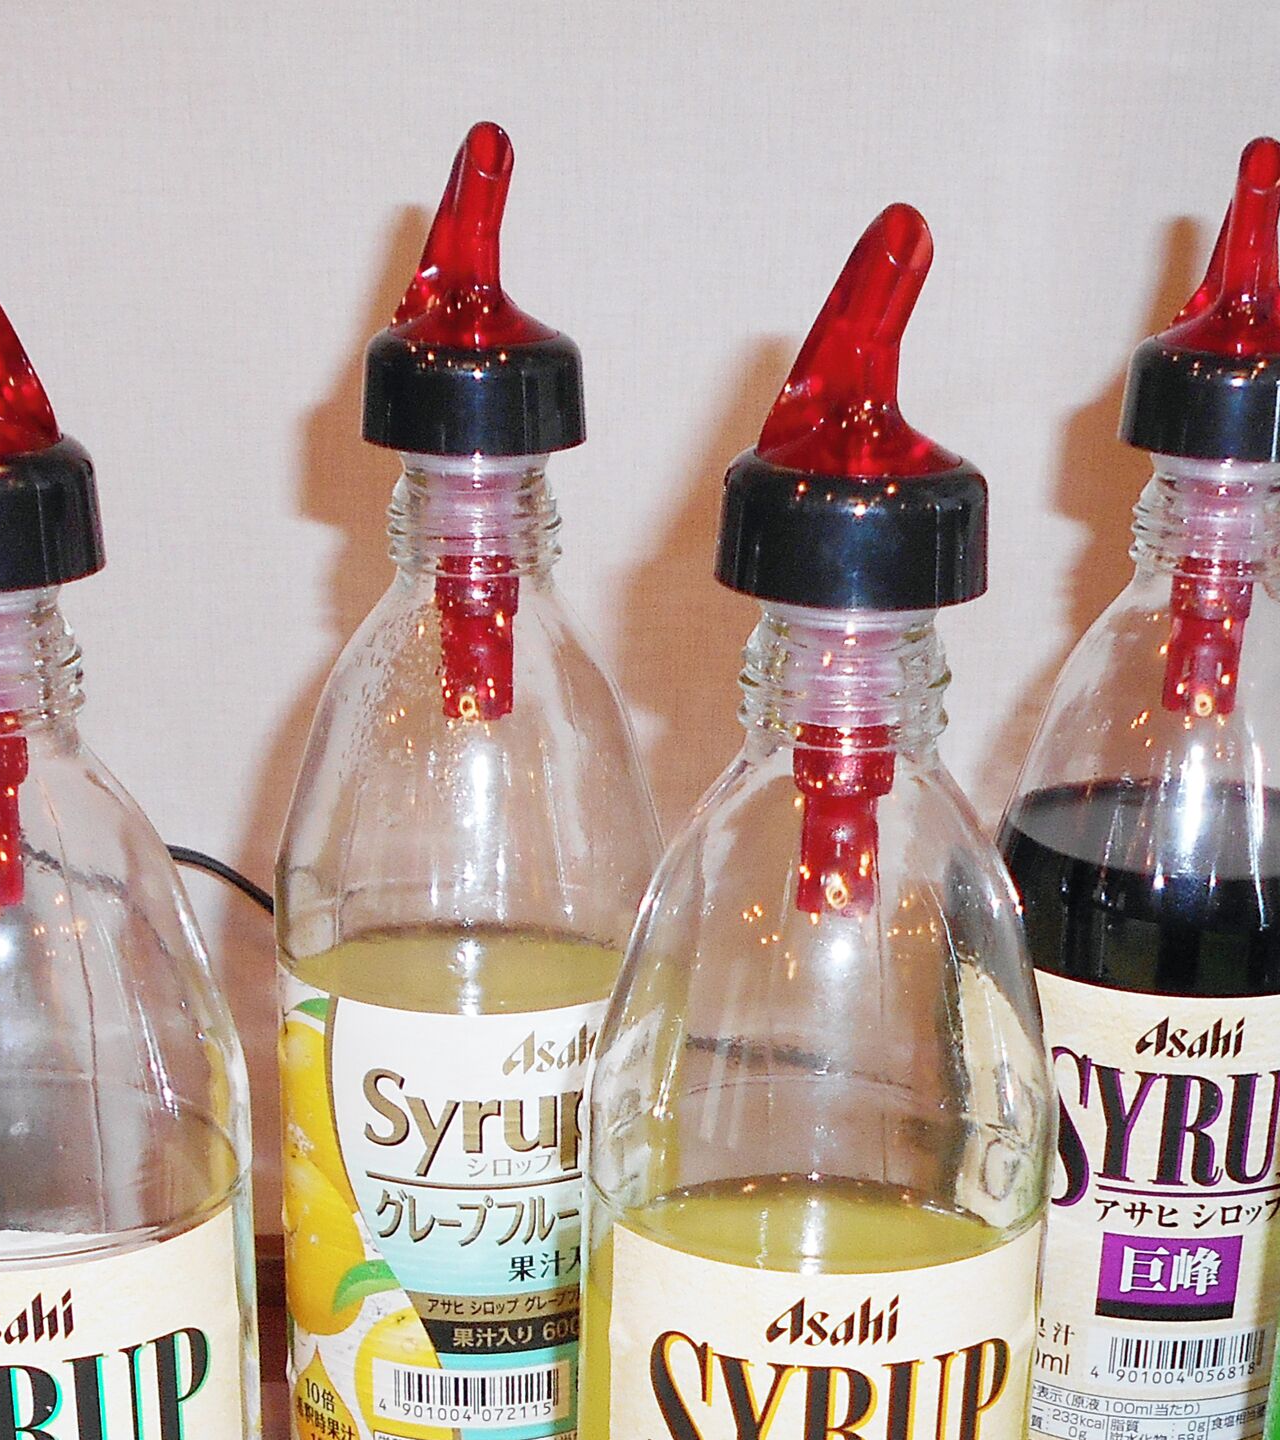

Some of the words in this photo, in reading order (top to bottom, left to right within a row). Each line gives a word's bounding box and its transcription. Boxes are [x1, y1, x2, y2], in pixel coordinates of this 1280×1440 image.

[502, 1021, 597, 1076] Asah
[1135, 1016, 1246, 1059] Asahi
[362, 1068, 583, 1177] Syrup
[375, 1188, 582, 1247] グレープフルー
[1094, 1196, 1180, 1229] アサヒ
[508, 1245, 582, 1283] 果汁入
[1119, 1245, 1222, 1296] 巨峰
[428, 1298, 464, 1316] アサヒ
[766, 1294, 900, 1346] Asahi
[453, 1326, 533, 1348] 果汁入り
[1035, 1347, 1070, 1377] ml
